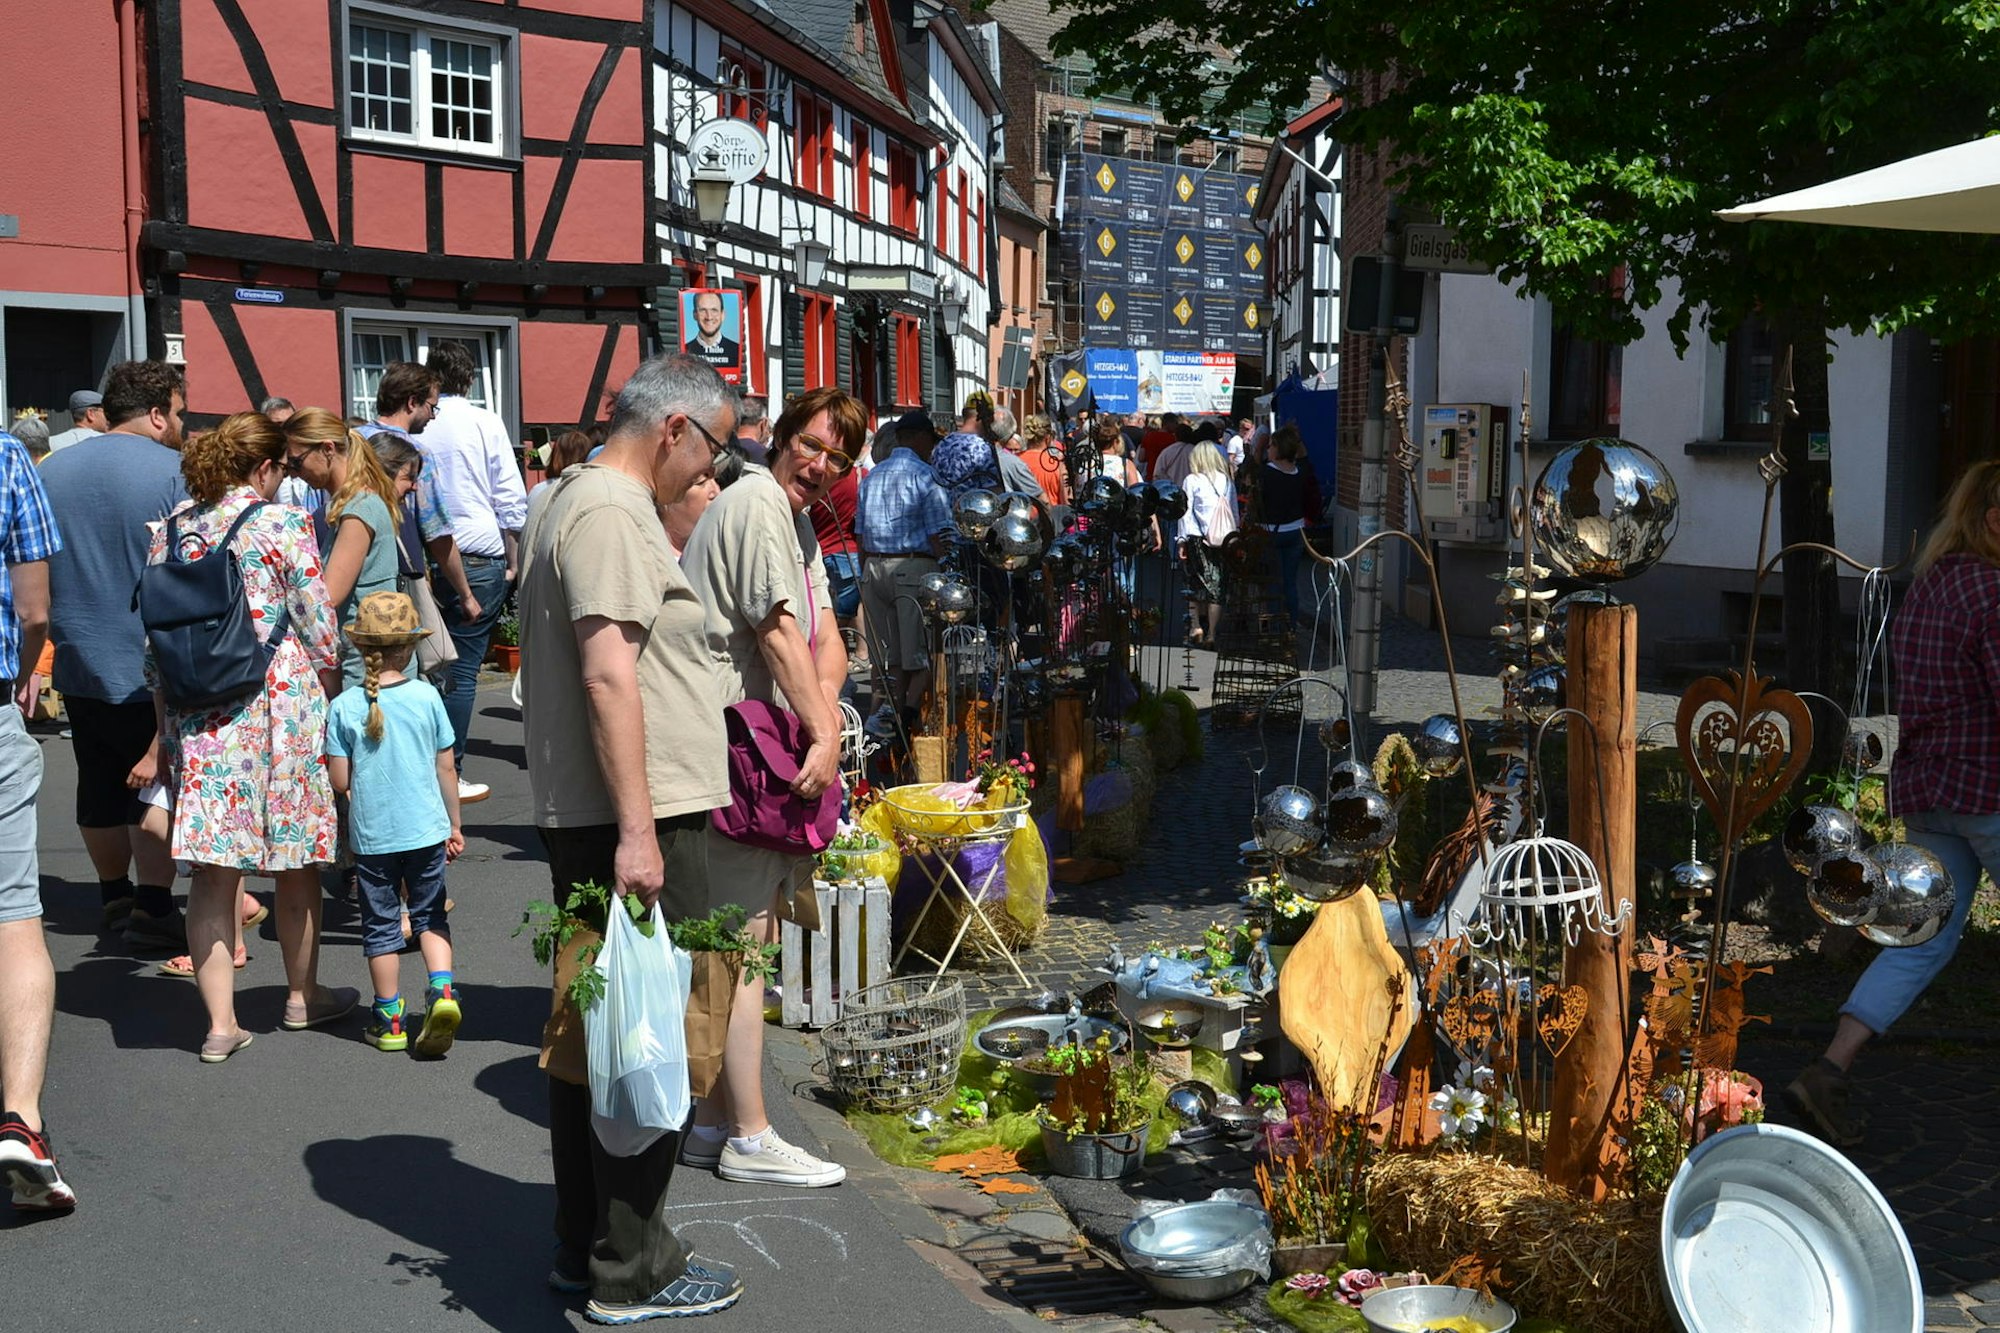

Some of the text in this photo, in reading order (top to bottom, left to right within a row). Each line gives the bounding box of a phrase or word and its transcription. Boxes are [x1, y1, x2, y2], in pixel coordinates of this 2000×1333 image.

[1410, 234, 1468, 265] Gielsgas
[171, 344, 177, 355] 5
[704, 345, 724, 353] Thilo
[1187, 355, 1214, 364] PARTNER
[1215, 356, 1226, 364] AM
